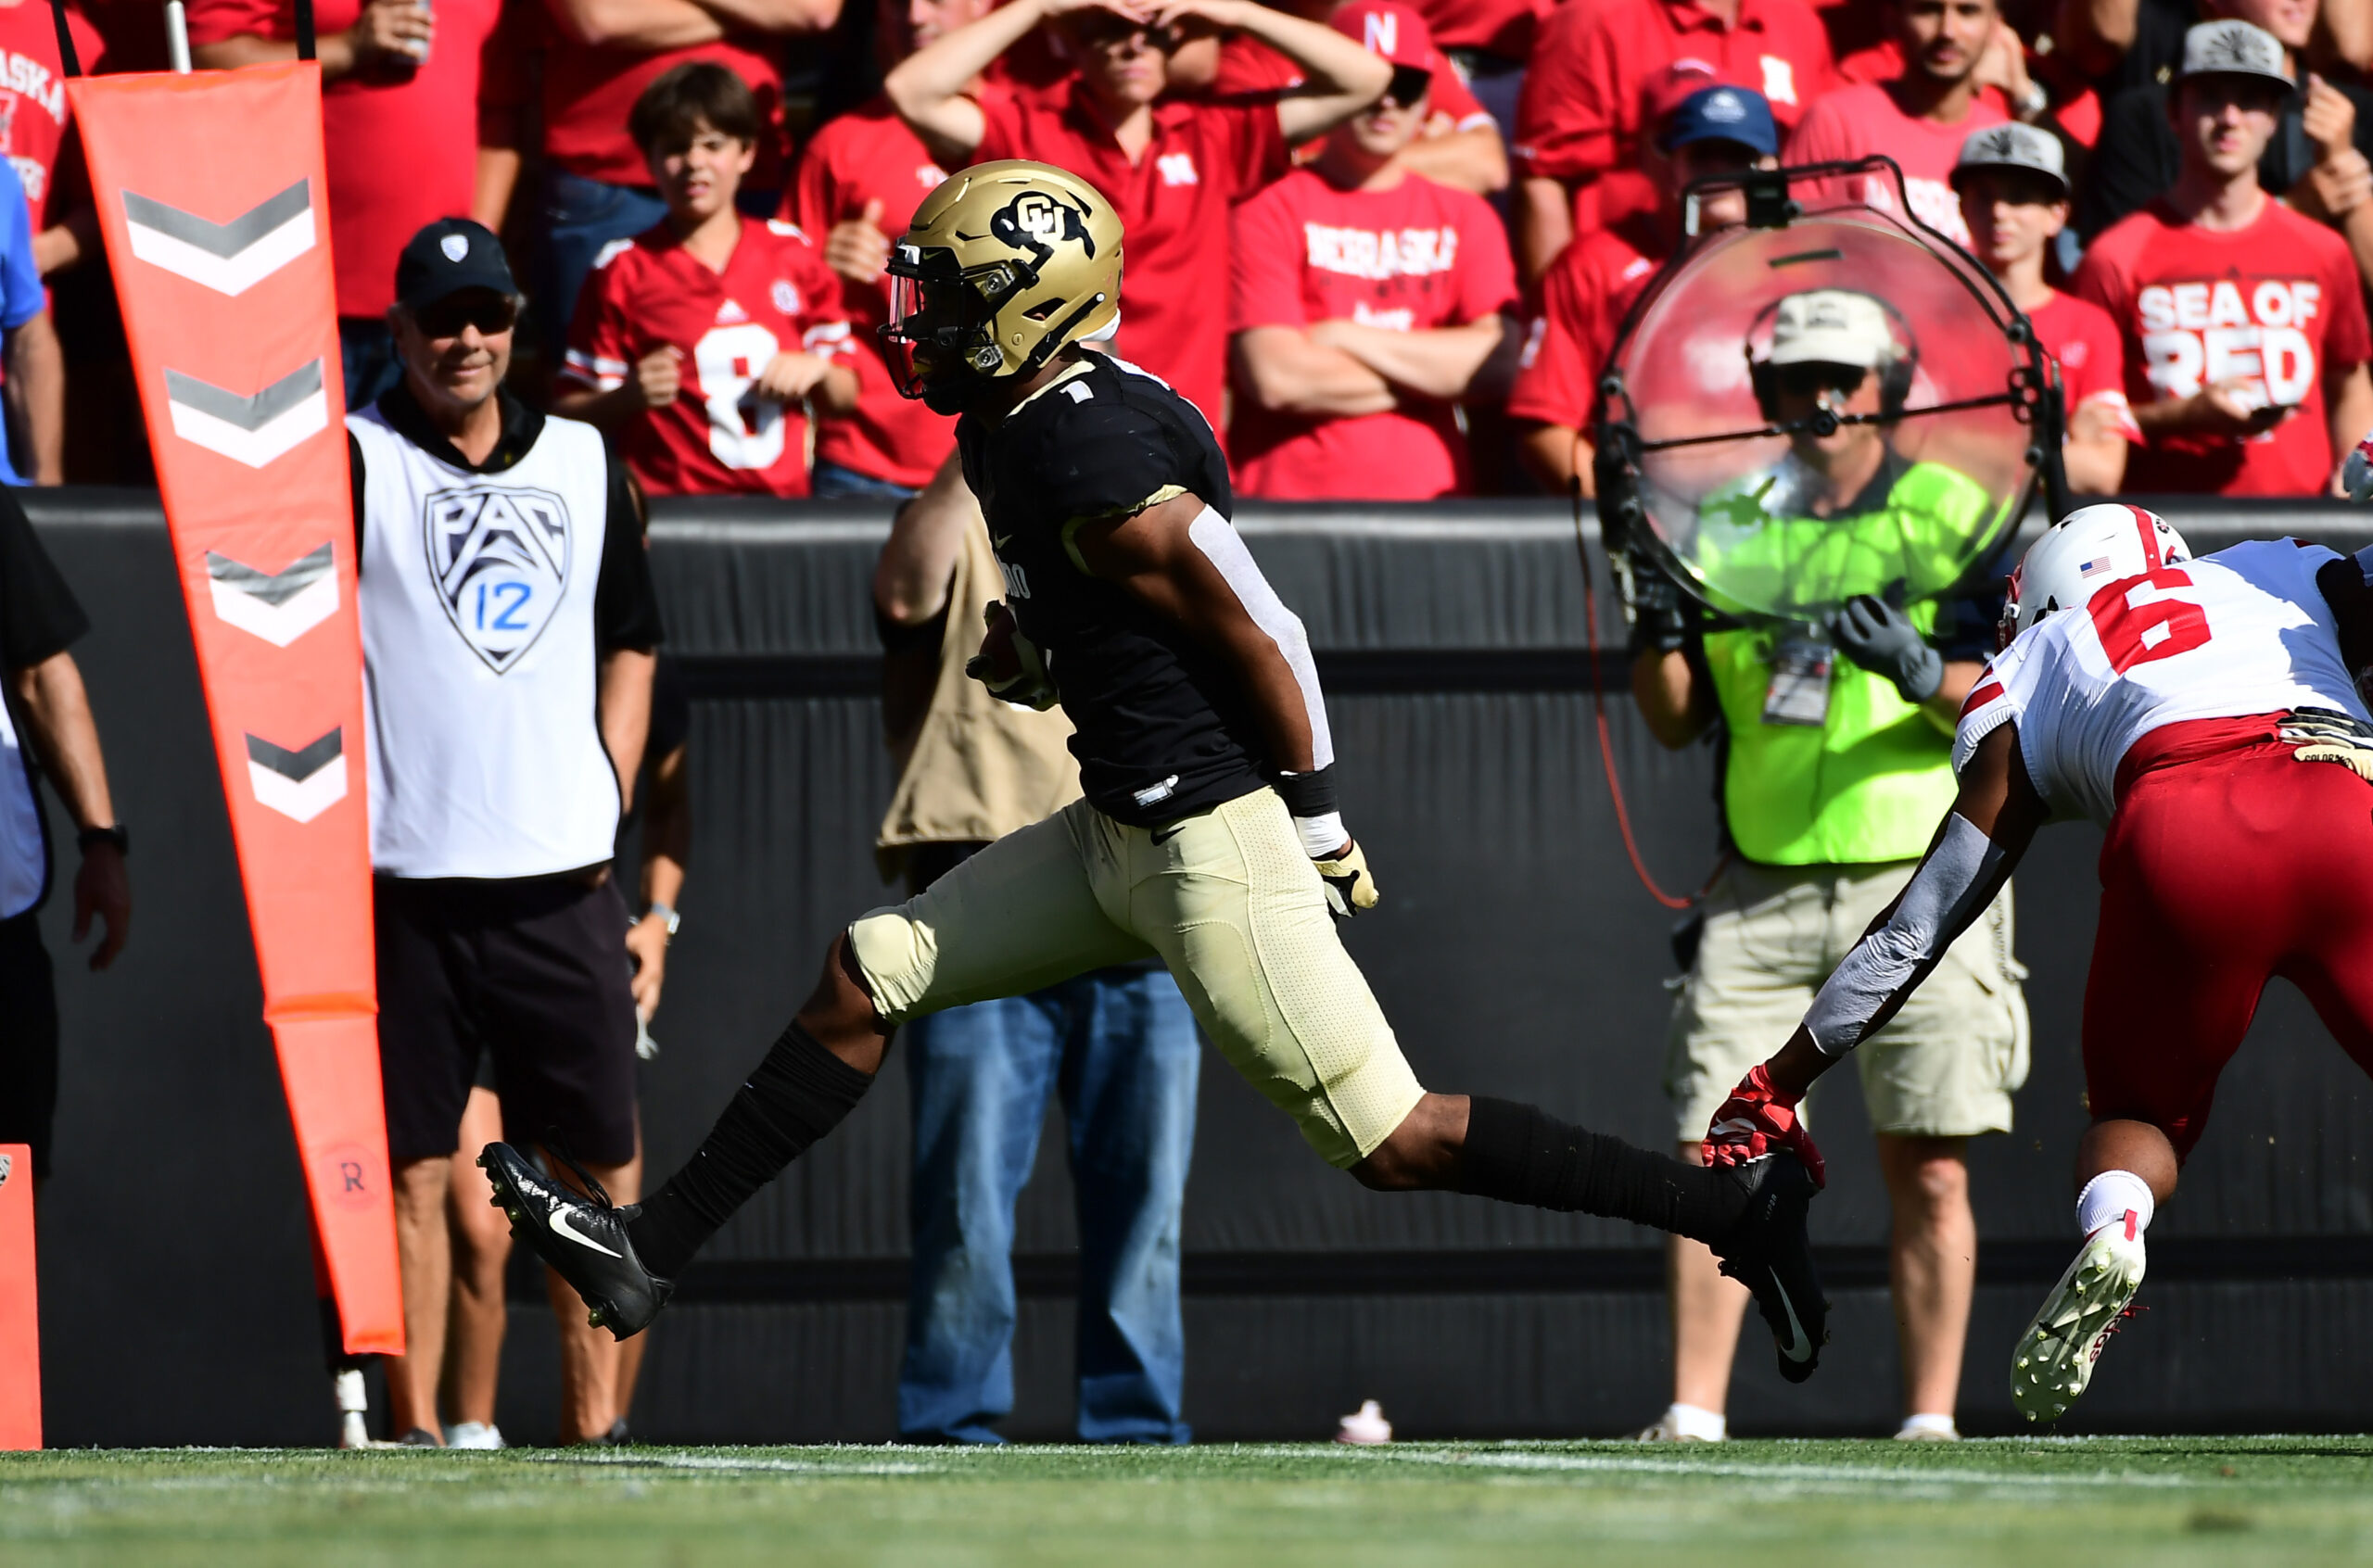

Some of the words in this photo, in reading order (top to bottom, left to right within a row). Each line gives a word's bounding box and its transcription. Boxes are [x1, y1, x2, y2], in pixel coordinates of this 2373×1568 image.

[1364, 11, 1397, 56] N
[1017, 196, 1065, 242] CU
[2138, 281, 2250, 330] SEA
[2253, 280, 2321, 329] OF
[2142, 326, 2316, 408] RED
[433, 494, 565, 596] PAC
[476, 582, 531, 631] 12
[2087, 567, 2213, 677] 6
[2304, 753, 2353, 766] COLOR
[340, 1162, 364, 1193] R
